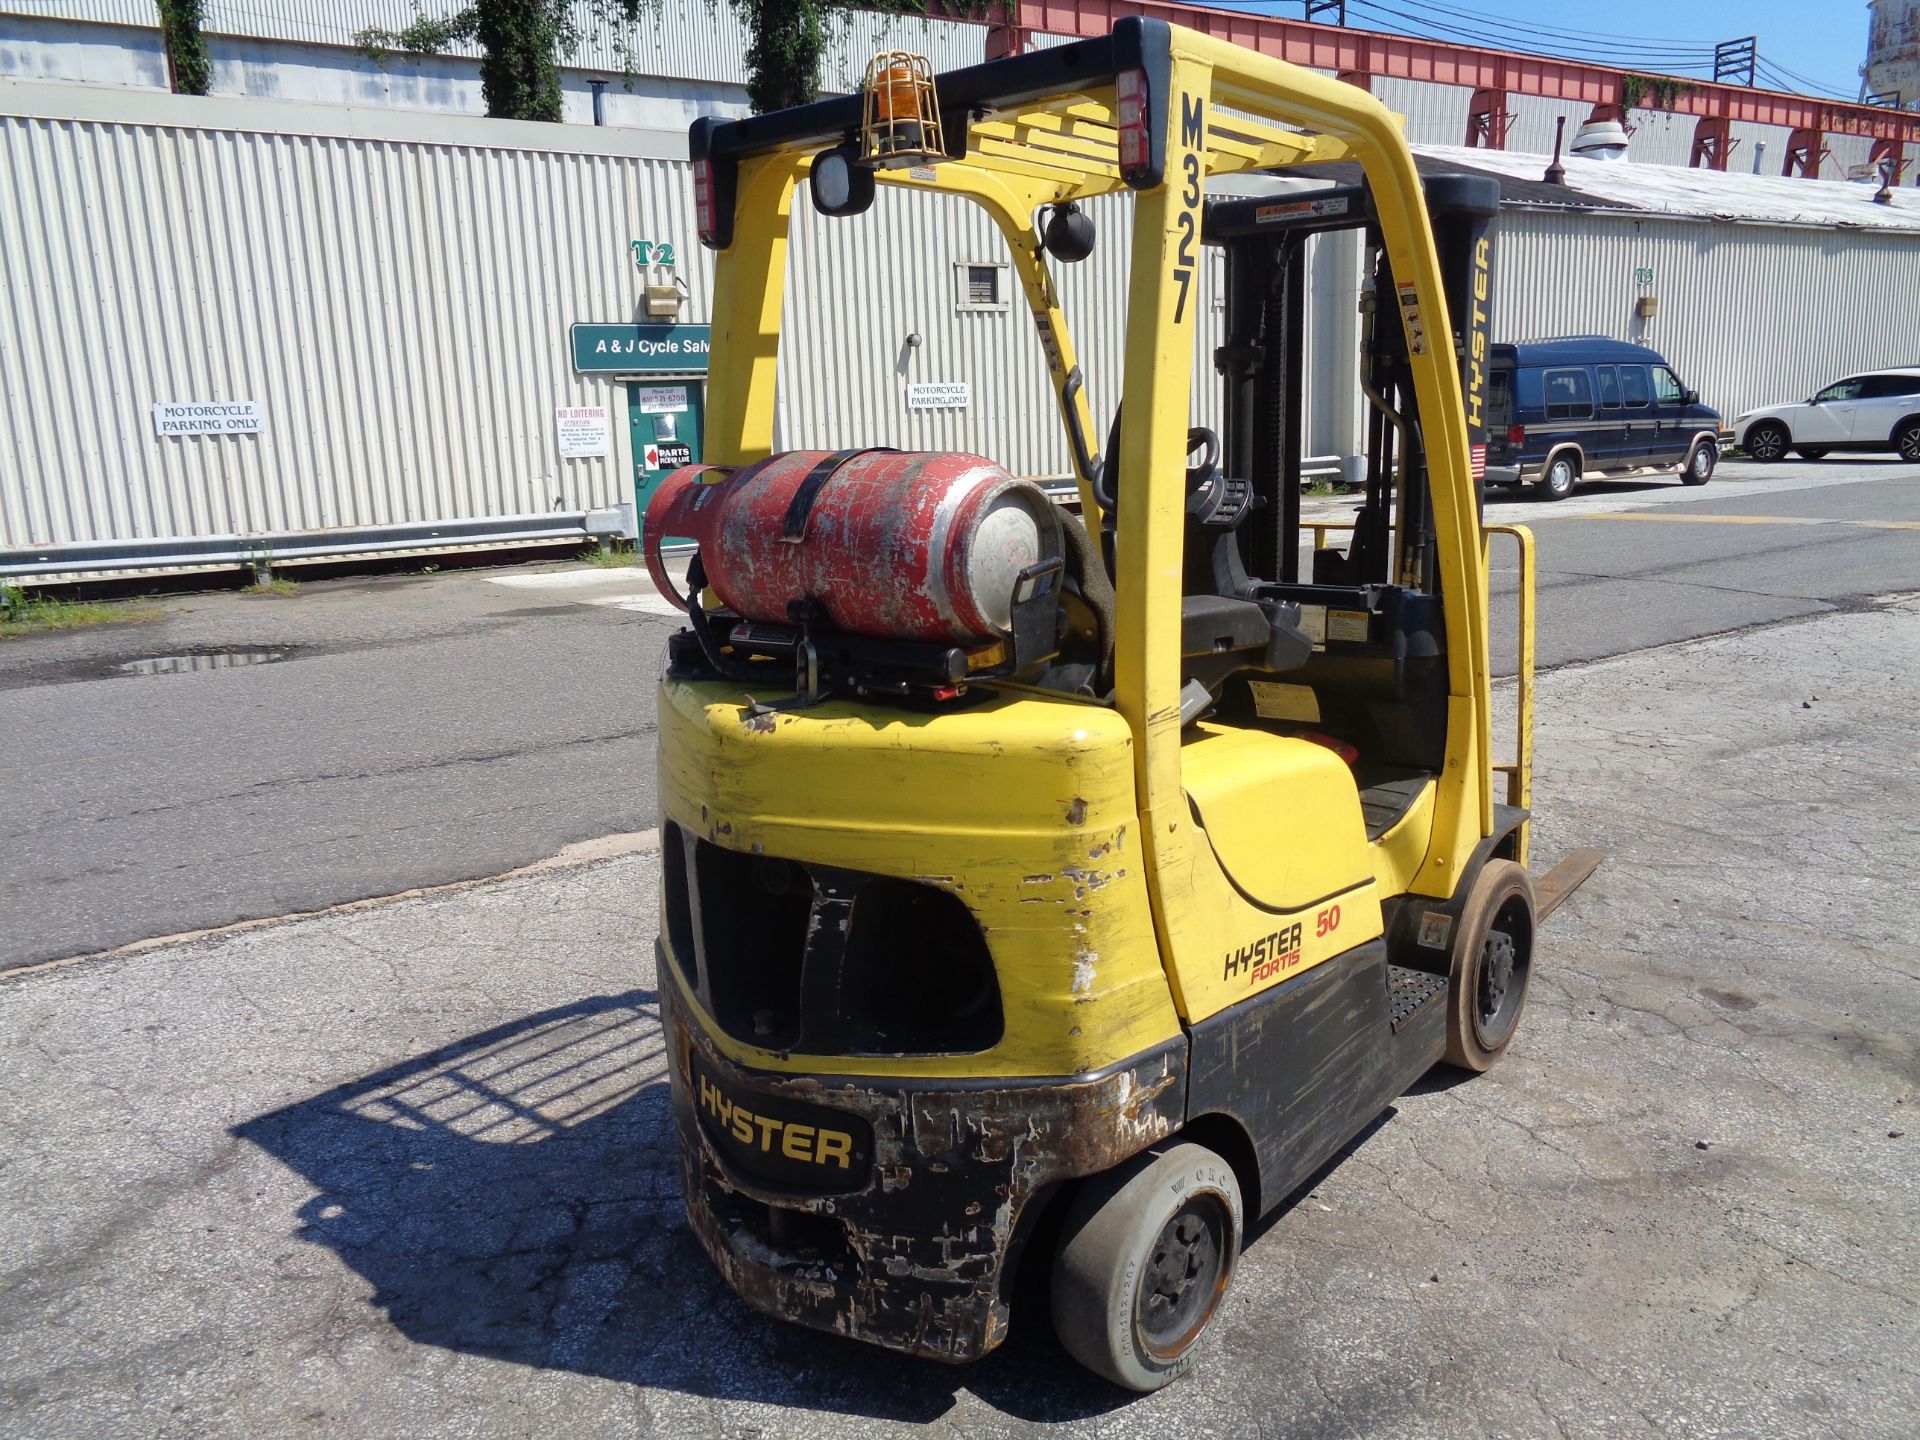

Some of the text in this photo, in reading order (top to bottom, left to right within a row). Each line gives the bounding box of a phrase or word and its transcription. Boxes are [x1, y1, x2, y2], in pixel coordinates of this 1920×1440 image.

[1173, 91, 1203, 324] M327
[631, 239, 676, 266] T2
[1636, 267, 1654, 283] T3
[1468, 235, 1489, 428] HYSTER
[596, 340, 607, 352] A
[611, 340, 622, 352] &
[626, 340, 634, 352] J
[638, 340, 678, 355] Cycle
[913, 386, 965, 394] MOTORCYCLE
[911, 396, 968, 405] PARKING ONLY
[164, 405, 253, 417] MOTORCYCLE
[557, 408, 605, 419] NO LOITERING
[162, 419, 259, 431] PARKING ONLY
[658, 448, 690, 457] PARTS
[1316, 904, 1341, 938] 50
[1223, 921, 1302, 982] HYSTER
[1250, 948, 1301, 986] FORTIS
[701, 1074, 852, 1169] HYSTER
